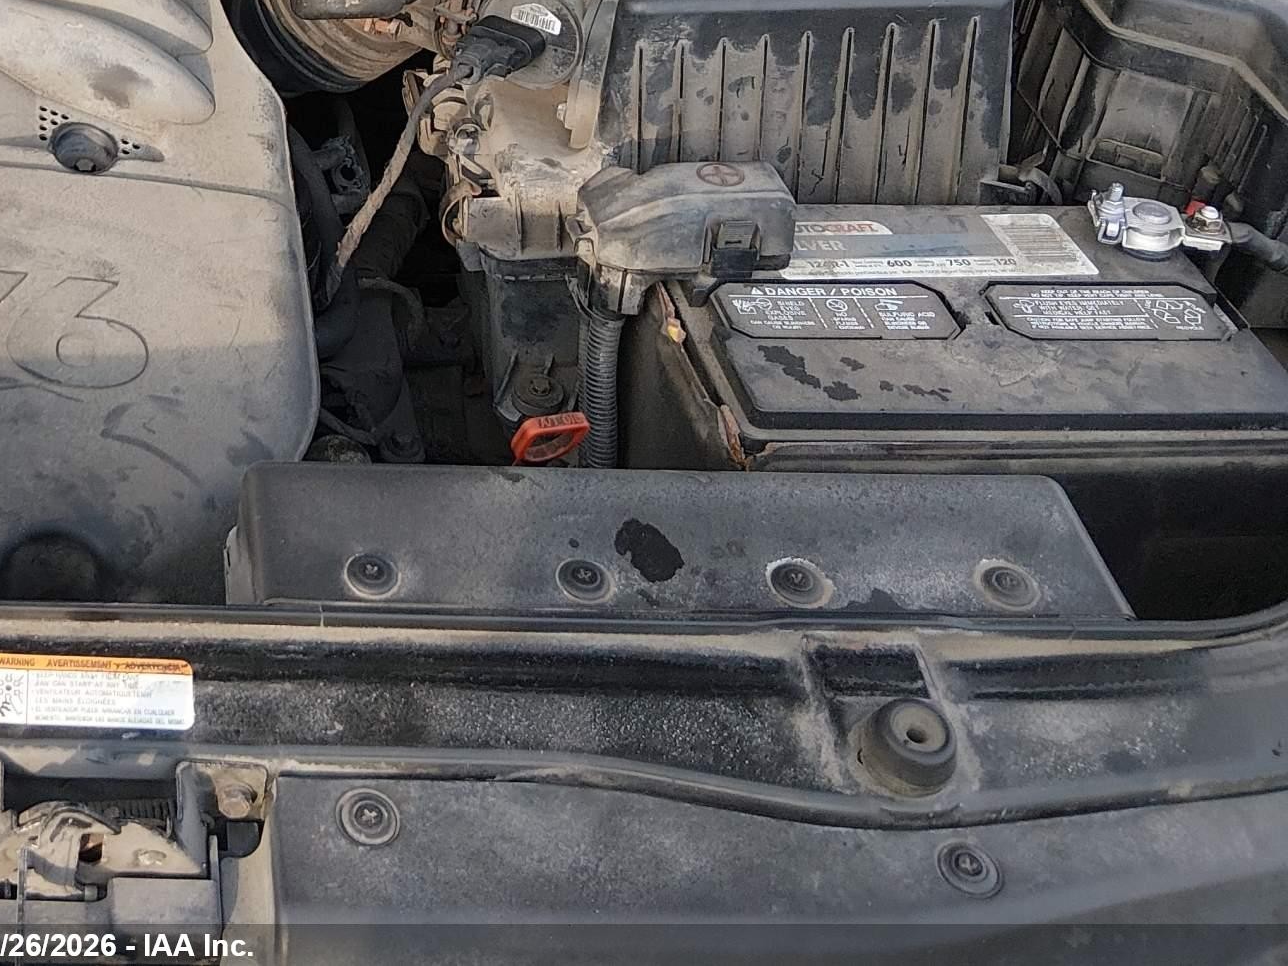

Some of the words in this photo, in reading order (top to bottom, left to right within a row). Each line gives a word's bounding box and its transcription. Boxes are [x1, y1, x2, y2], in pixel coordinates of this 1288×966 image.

[795, 224, 876, 233] UTOCRAFT
[793, 240, 848, 251] LVER
[886, 260, 913, 268] 600
[945, 258, 971, 267] 750
[993, 258, 1016, 266] 120
[765, 287, 826, 296] DANGER
[829, 288, 836, 296] /
[840, 287, 897, 296] POISON
[45, 659, 113, 669] AVERTISSEMENT
